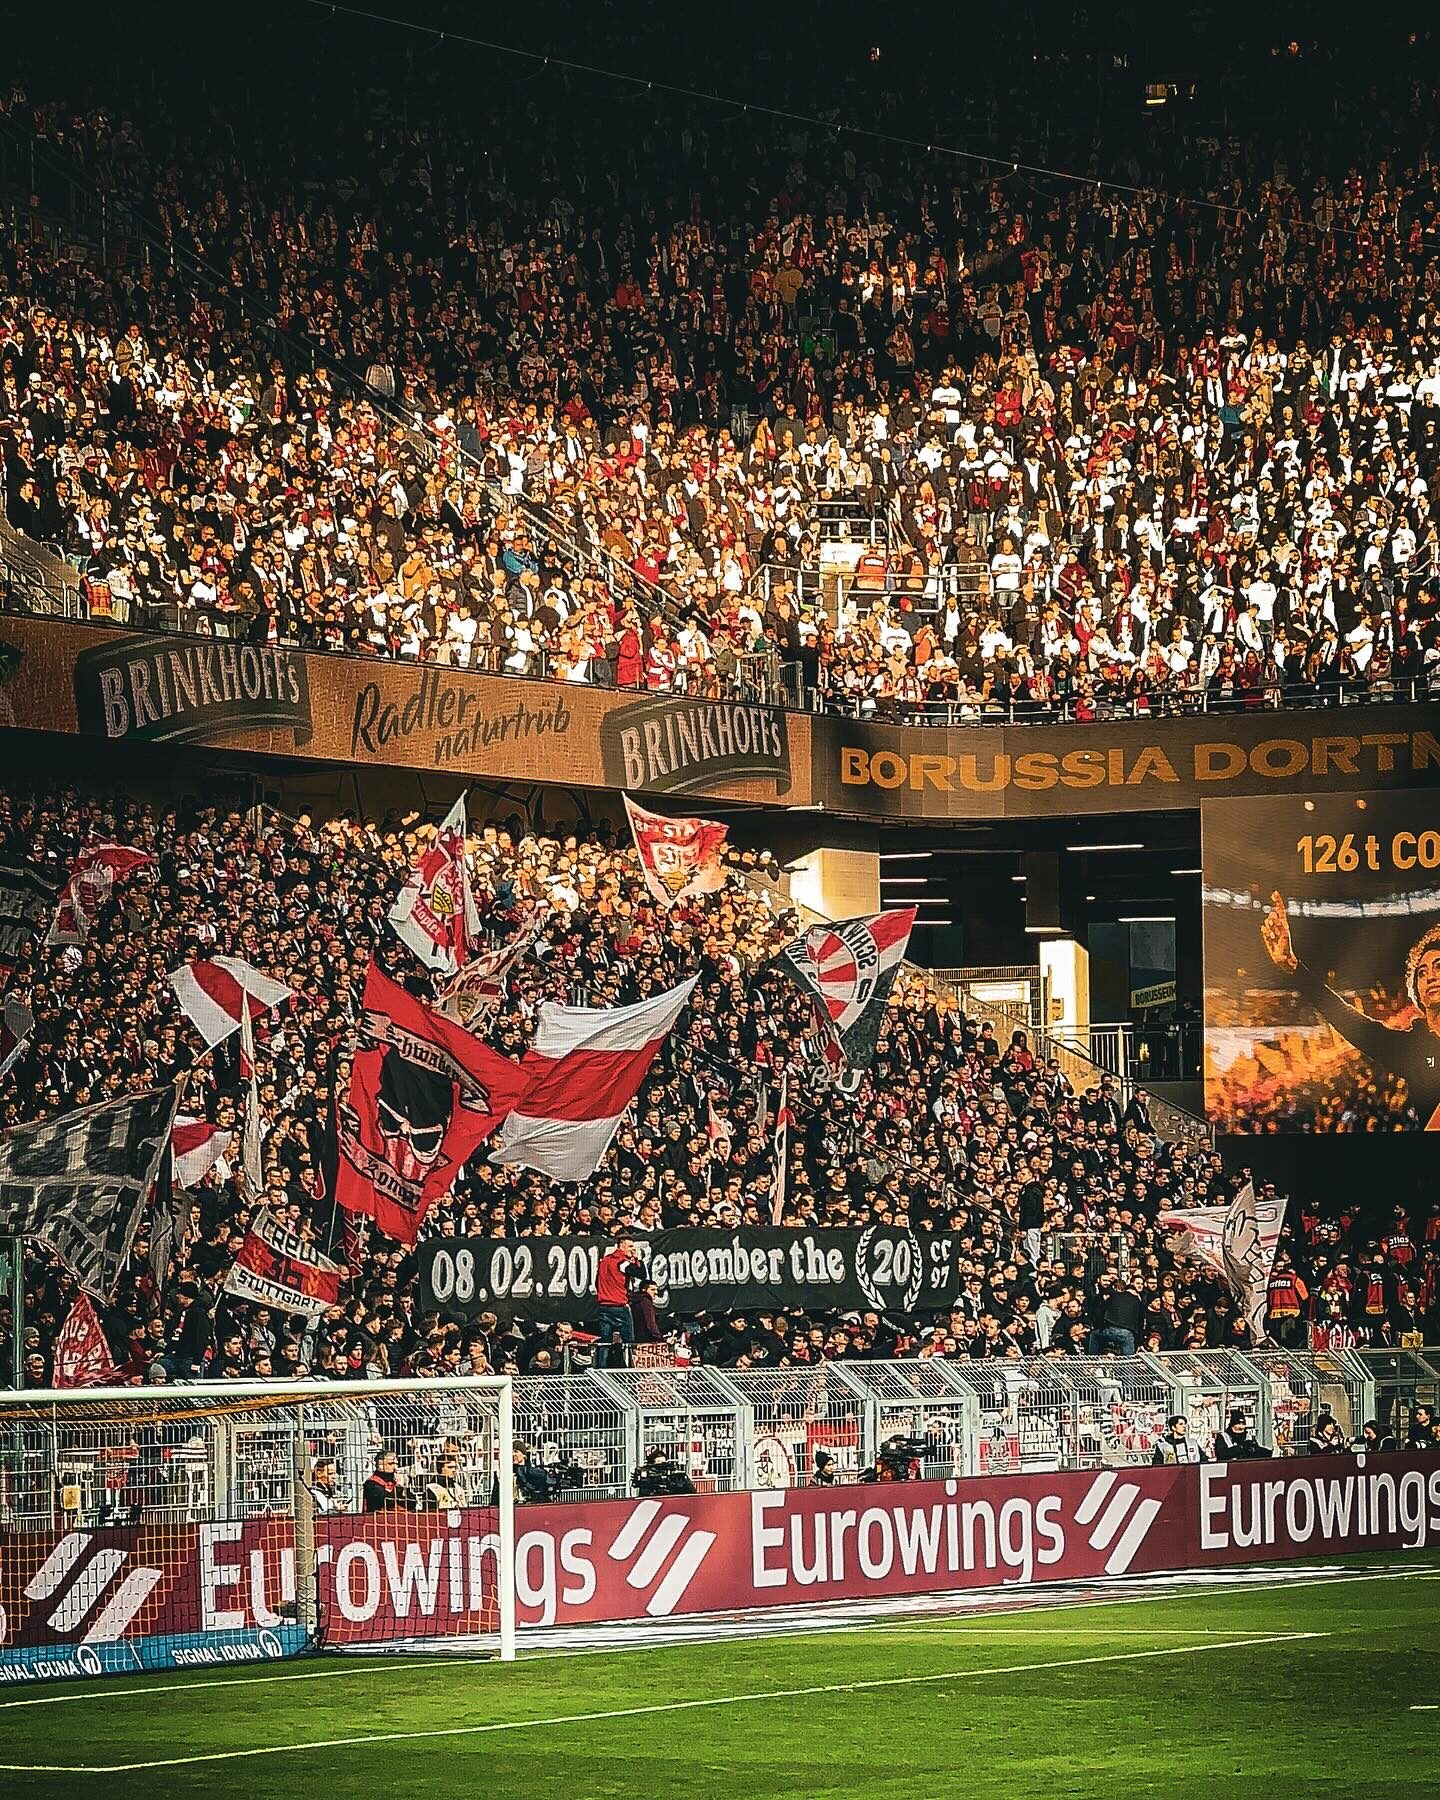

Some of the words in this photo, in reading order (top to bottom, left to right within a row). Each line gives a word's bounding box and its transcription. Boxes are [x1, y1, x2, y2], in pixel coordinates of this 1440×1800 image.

[100, 647, 300, 738] BRINKHOFF's
[352, 670, 477, 757] Radler
[619, 706, 782, 790] BRINKHOFF's
[841, 744, 1181, 792] BORUSSIA
[1297, 833, 1360, 873] 126
[1365, 835, 1380, 870] t
[236, 1269, 322, 1311] STUTTGART
[431, 1245, 619, 1303] 08.02.201
[789, 1236, 846, 1284] the
[872, 1239, 911, 1286] 20
[930, 1265, 950, 1289] 97
[751, 1480, 1065, 1587] Eurowings
[33, 1660, 80, 1678] IDUNA
[171, 1645, 223, 1665] SIGNAL
[219, 1643, 264, 1661] IDUNA
